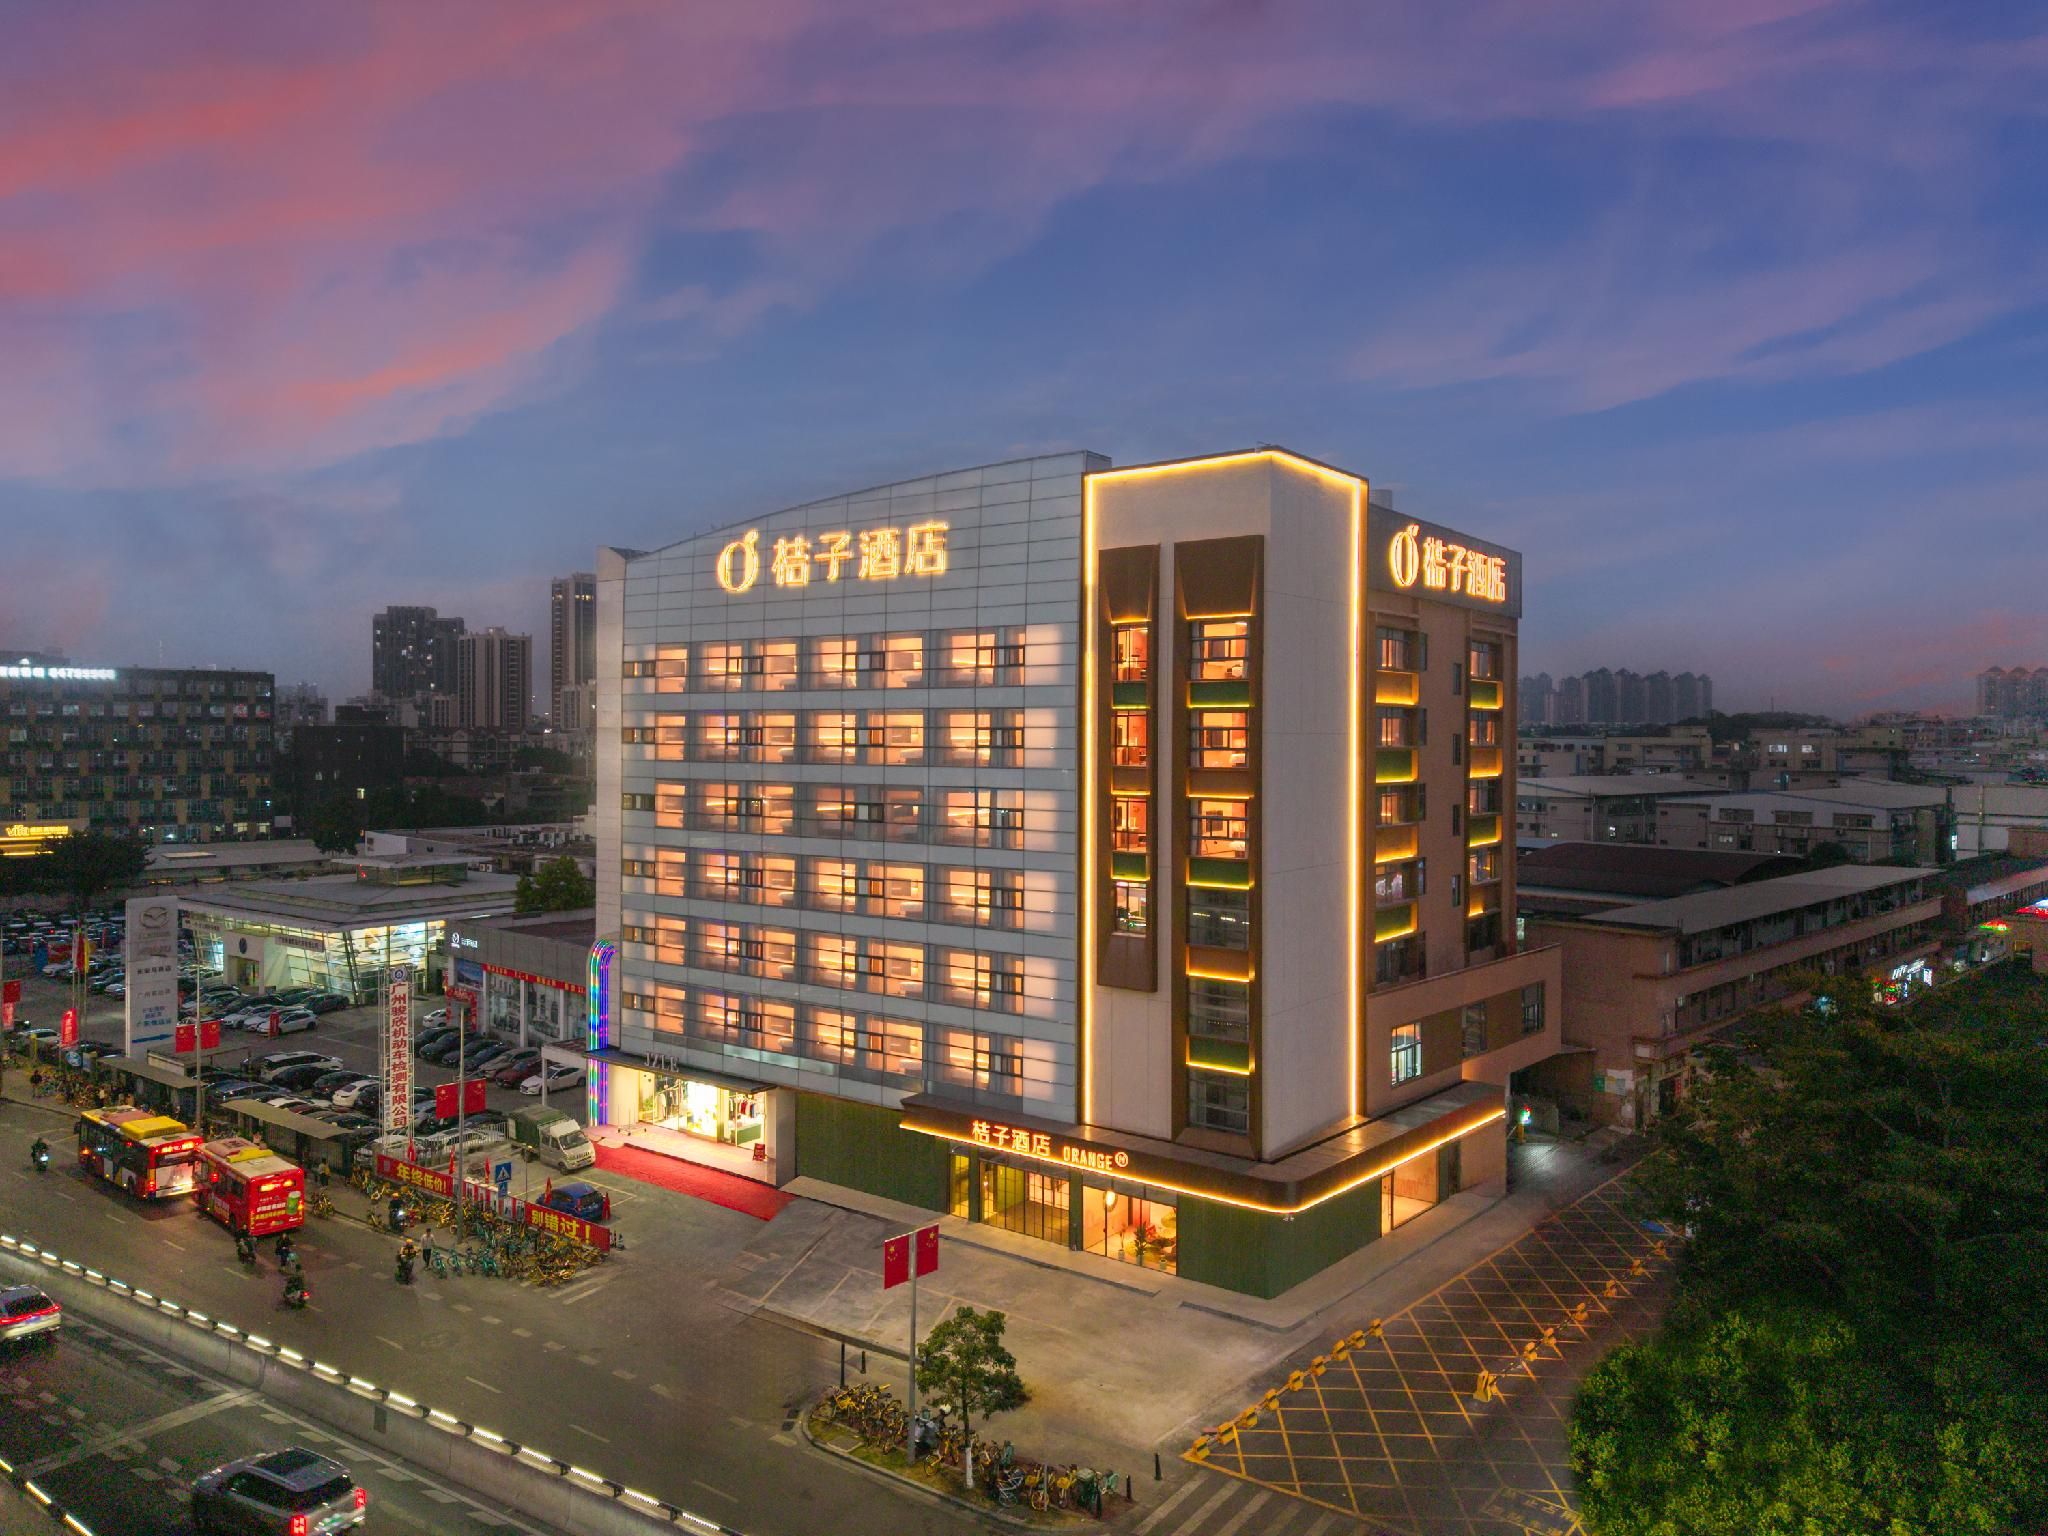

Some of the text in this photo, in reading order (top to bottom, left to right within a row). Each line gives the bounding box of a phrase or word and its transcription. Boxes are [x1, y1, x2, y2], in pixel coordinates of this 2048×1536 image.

[771, 520, 949, 587] 桔子酒店
[1423, 537, 1506, 602] 桔子酒店
[972, 1119, 1052, 1158] 桔子酒店
[1062, 1145, 1114, 1171] ORANGE
